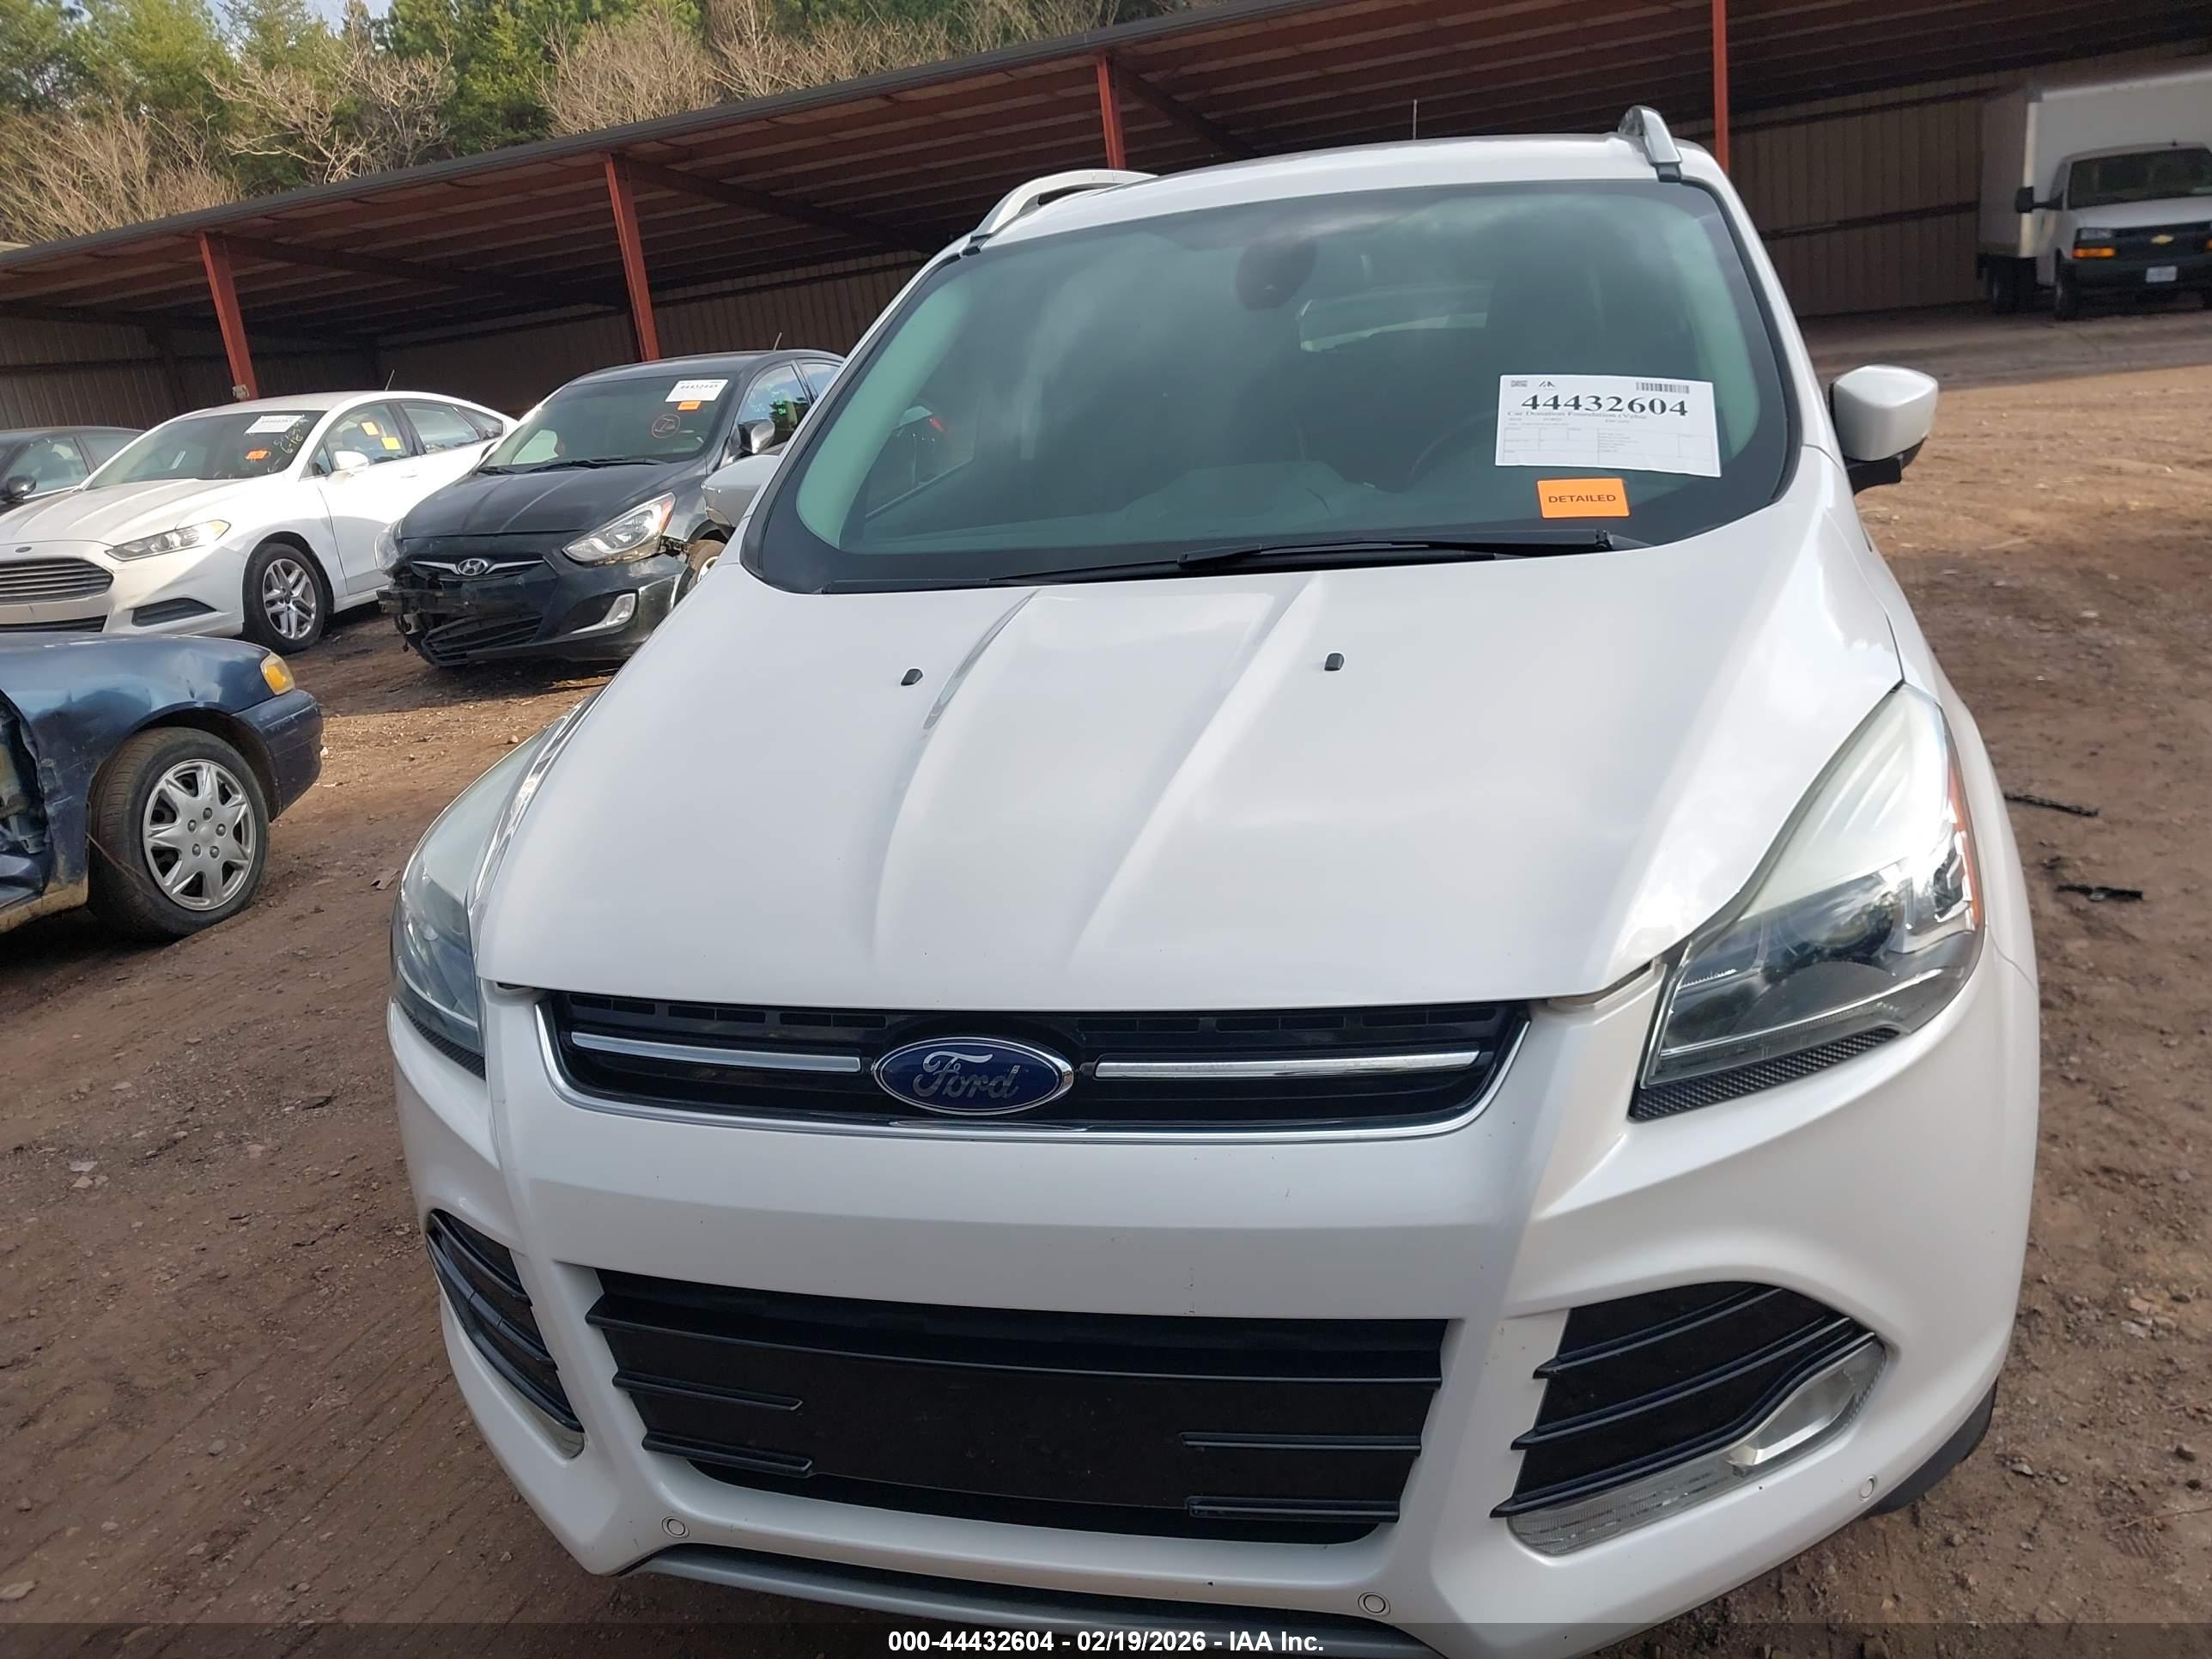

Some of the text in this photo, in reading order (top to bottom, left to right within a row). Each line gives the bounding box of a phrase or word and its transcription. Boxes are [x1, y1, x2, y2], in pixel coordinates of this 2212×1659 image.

[1522, 394, 1688, 416] 44432604
[1548, 494, 1616, 503] DETAILED
[913, 1050, 1019, 1098] Ford
